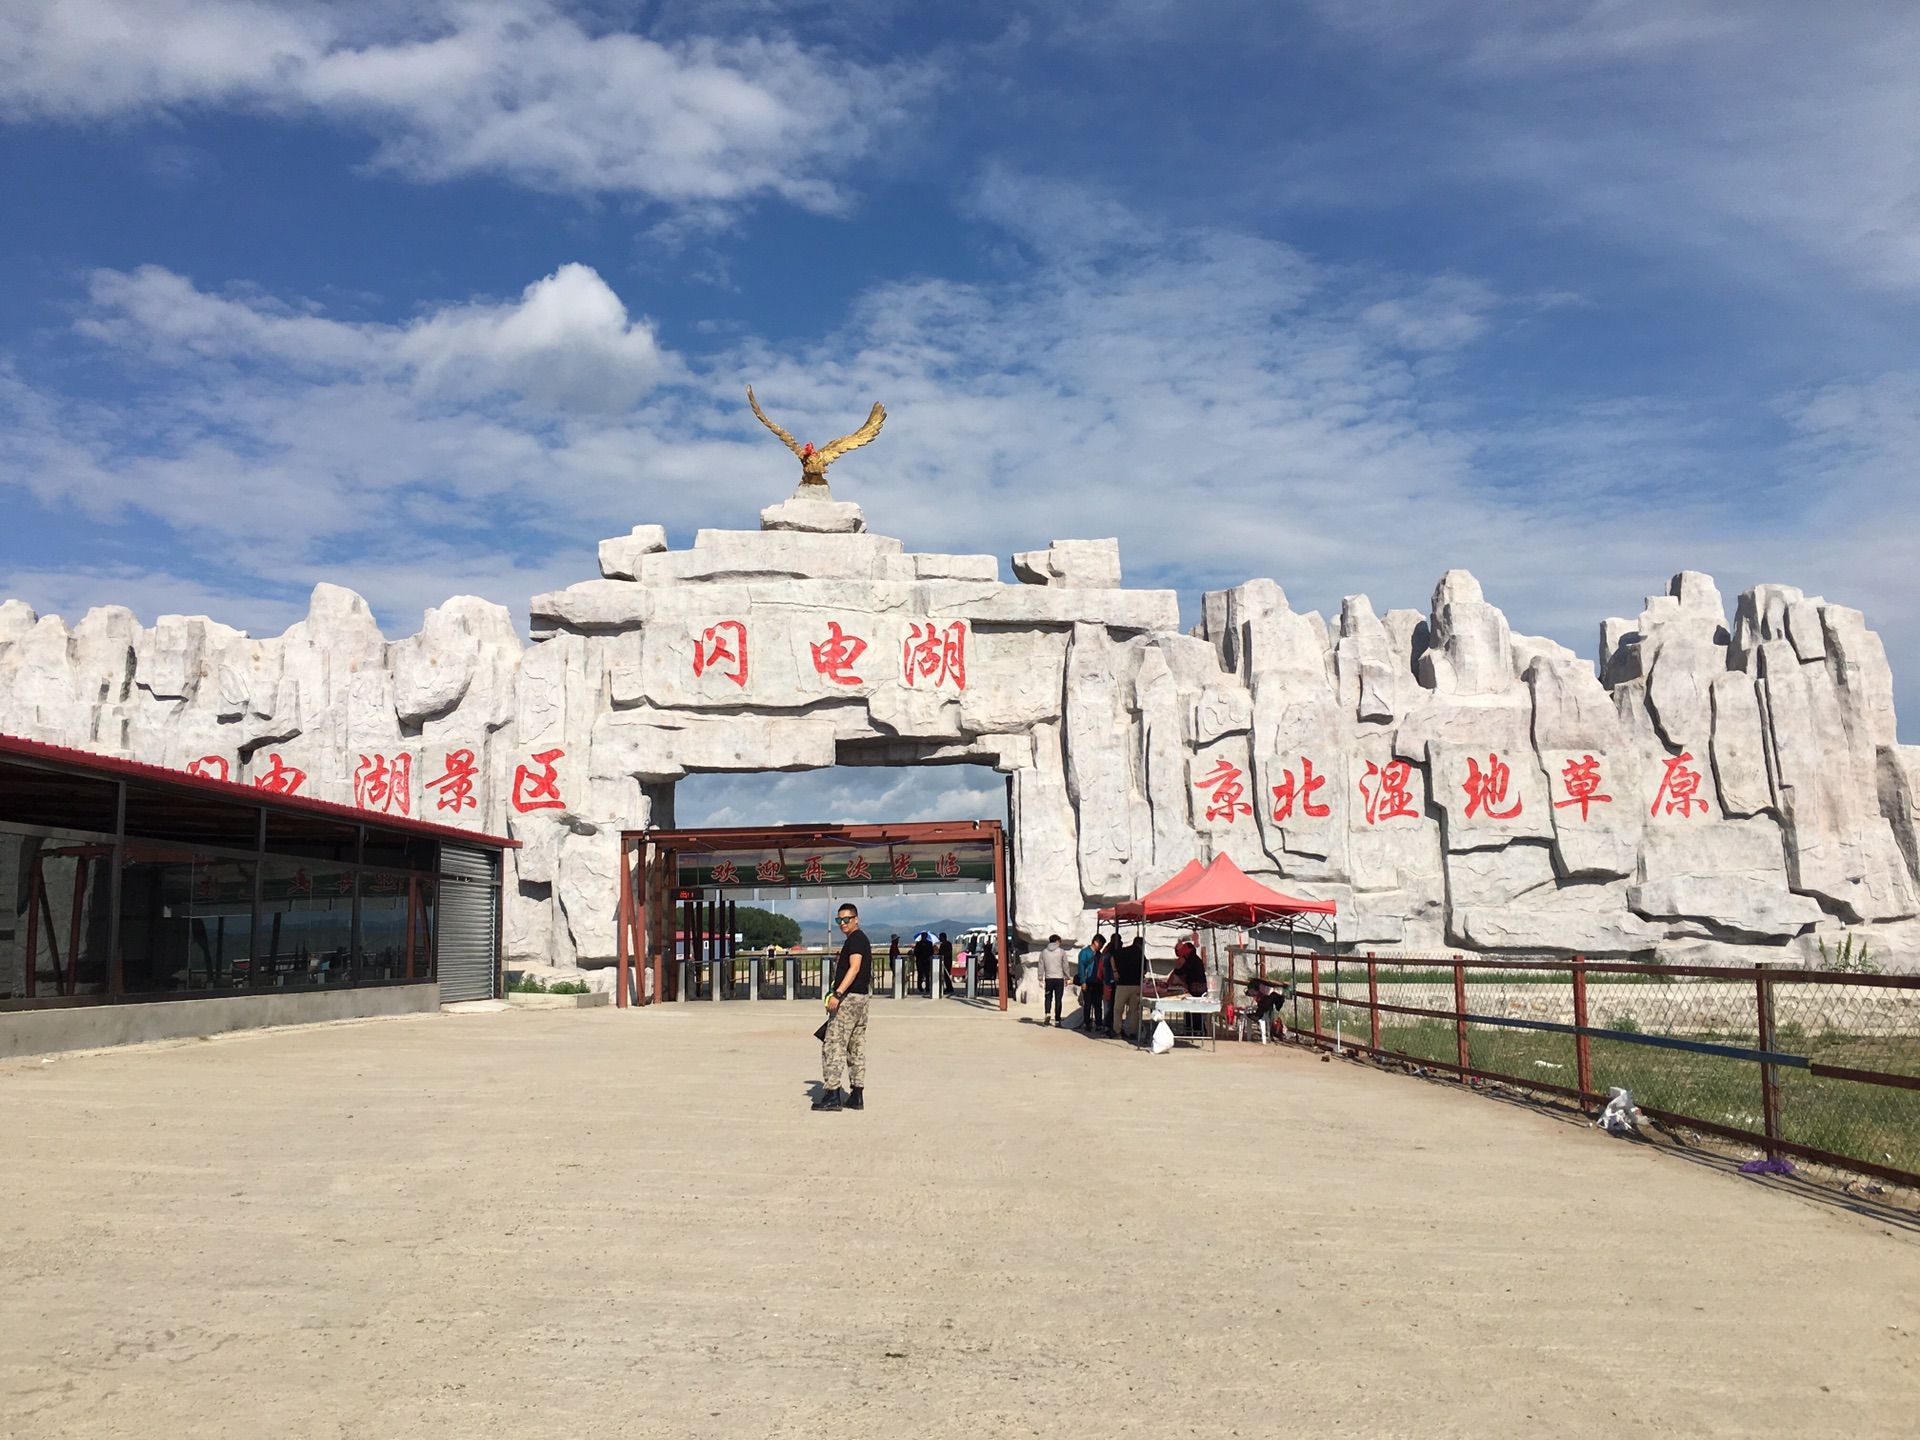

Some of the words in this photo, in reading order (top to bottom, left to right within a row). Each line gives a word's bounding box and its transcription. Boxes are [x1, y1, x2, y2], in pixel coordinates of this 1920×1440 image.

[691, 619, 967, 691] 闪电湖
[1194, 752, 1710, 825] 京北湿地草原
[711, 853, 961, 883] 欢迎再次光临
